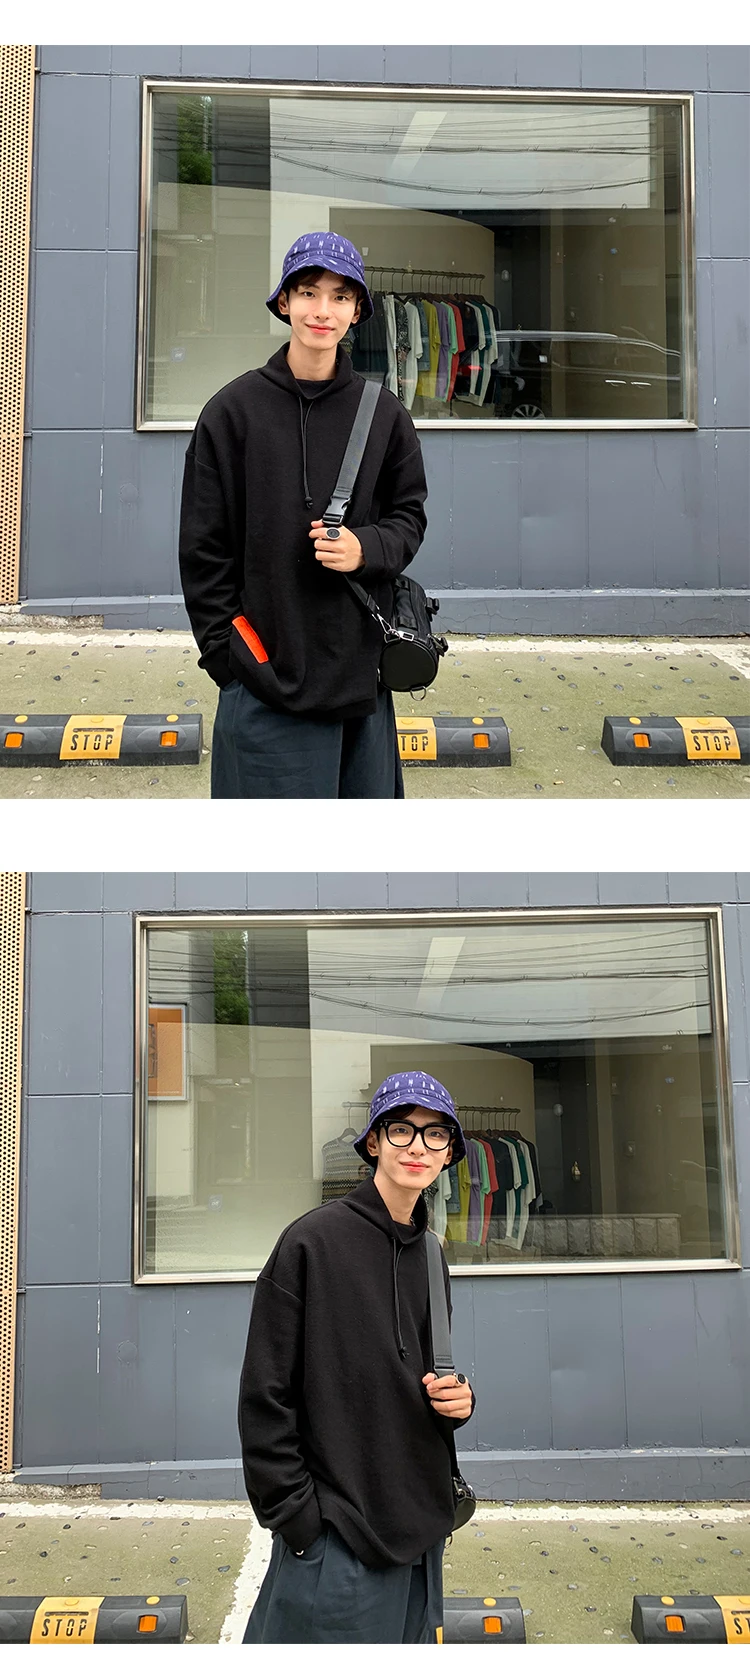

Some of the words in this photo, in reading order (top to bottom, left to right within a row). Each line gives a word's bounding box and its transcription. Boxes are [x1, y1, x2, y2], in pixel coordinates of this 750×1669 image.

[70, 734, 113, 751] STOP
[401, 735, 429, 751] TOP
[693, 735, 731, 751] STOP
[41, 1618, 87, 1637] STOP
[733, 1617, 750, 1635] ST
